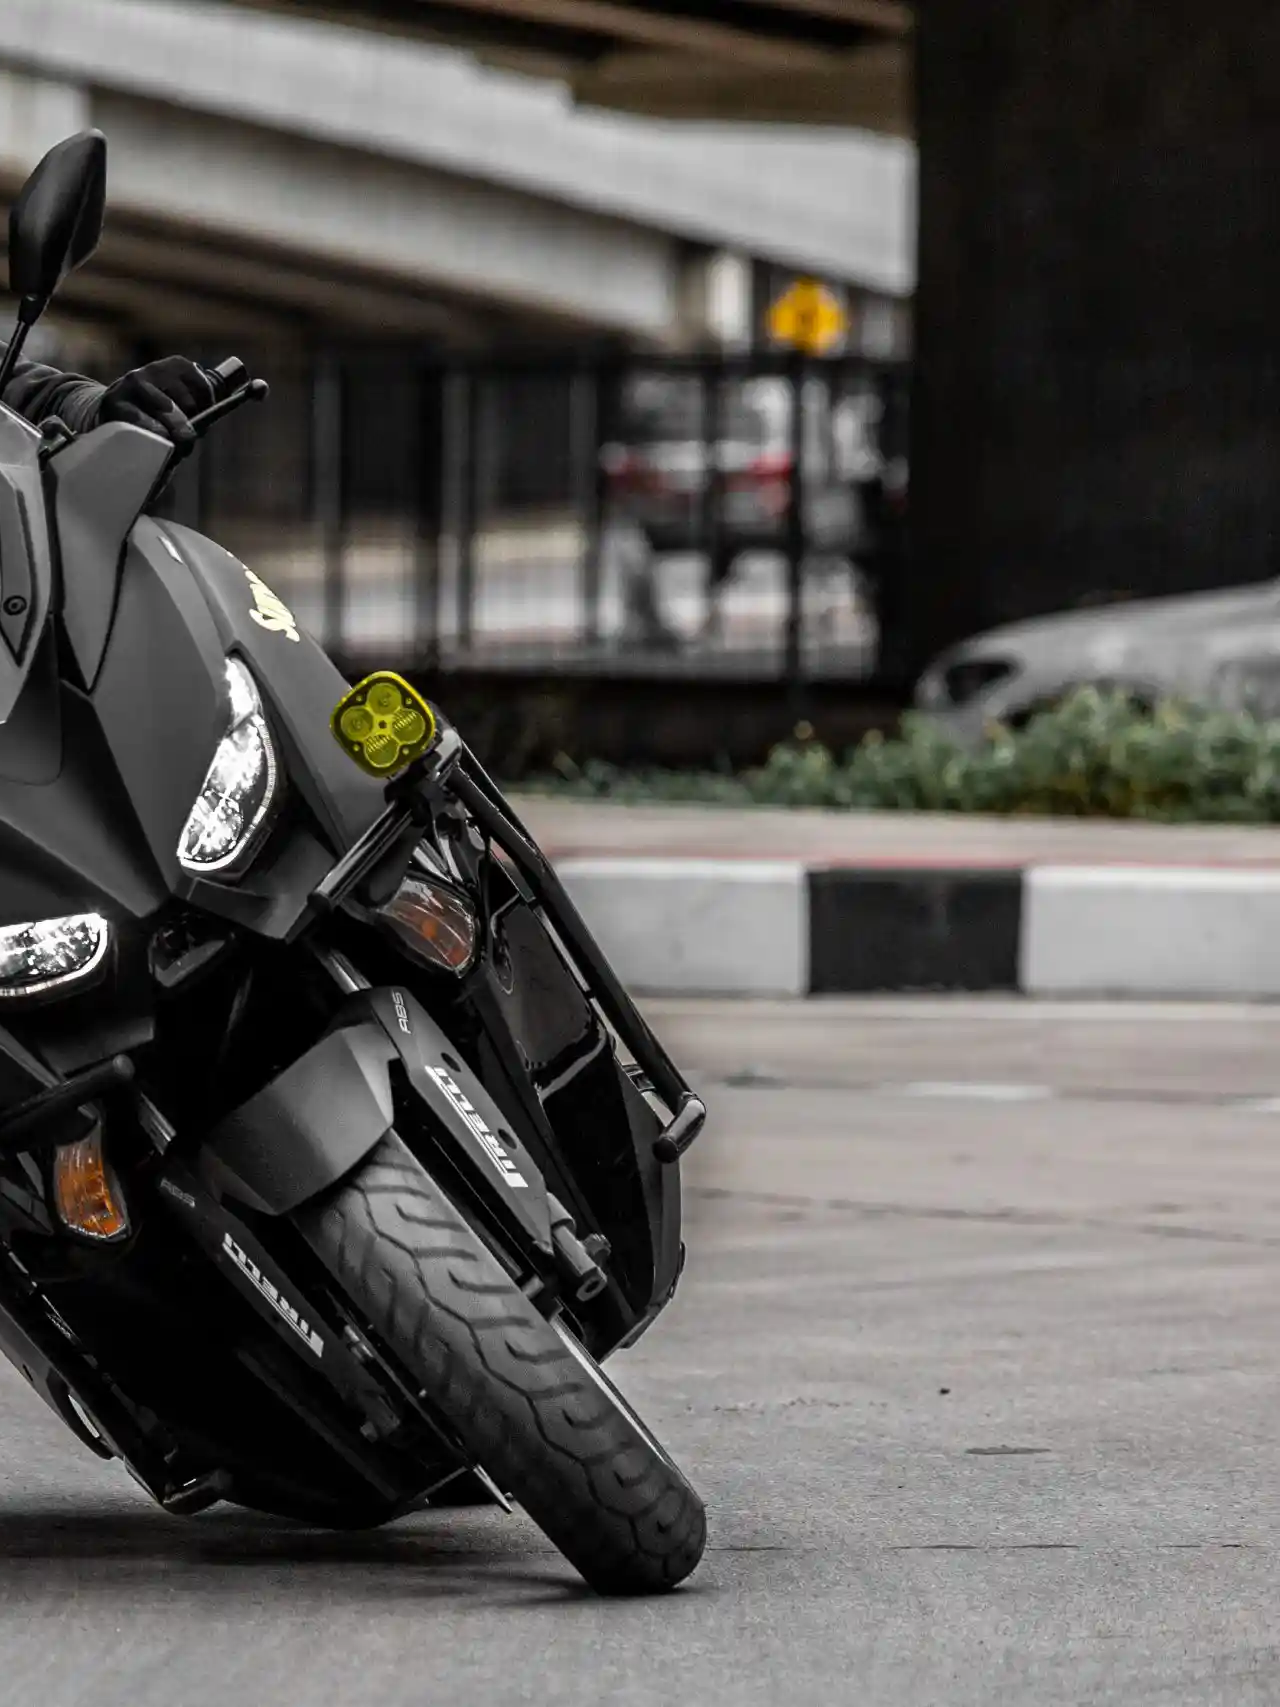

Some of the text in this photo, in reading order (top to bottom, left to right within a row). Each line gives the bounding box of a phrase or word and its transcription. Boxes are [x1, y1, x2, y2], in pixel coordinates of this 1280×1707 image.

[392, 990, 411, 1034] ABS
[424, 1065, 529, 1187] PIRELLI
[160, 1177, 196, 1208] ABS
[222, 1232, 324, 1358] PIRELLI
